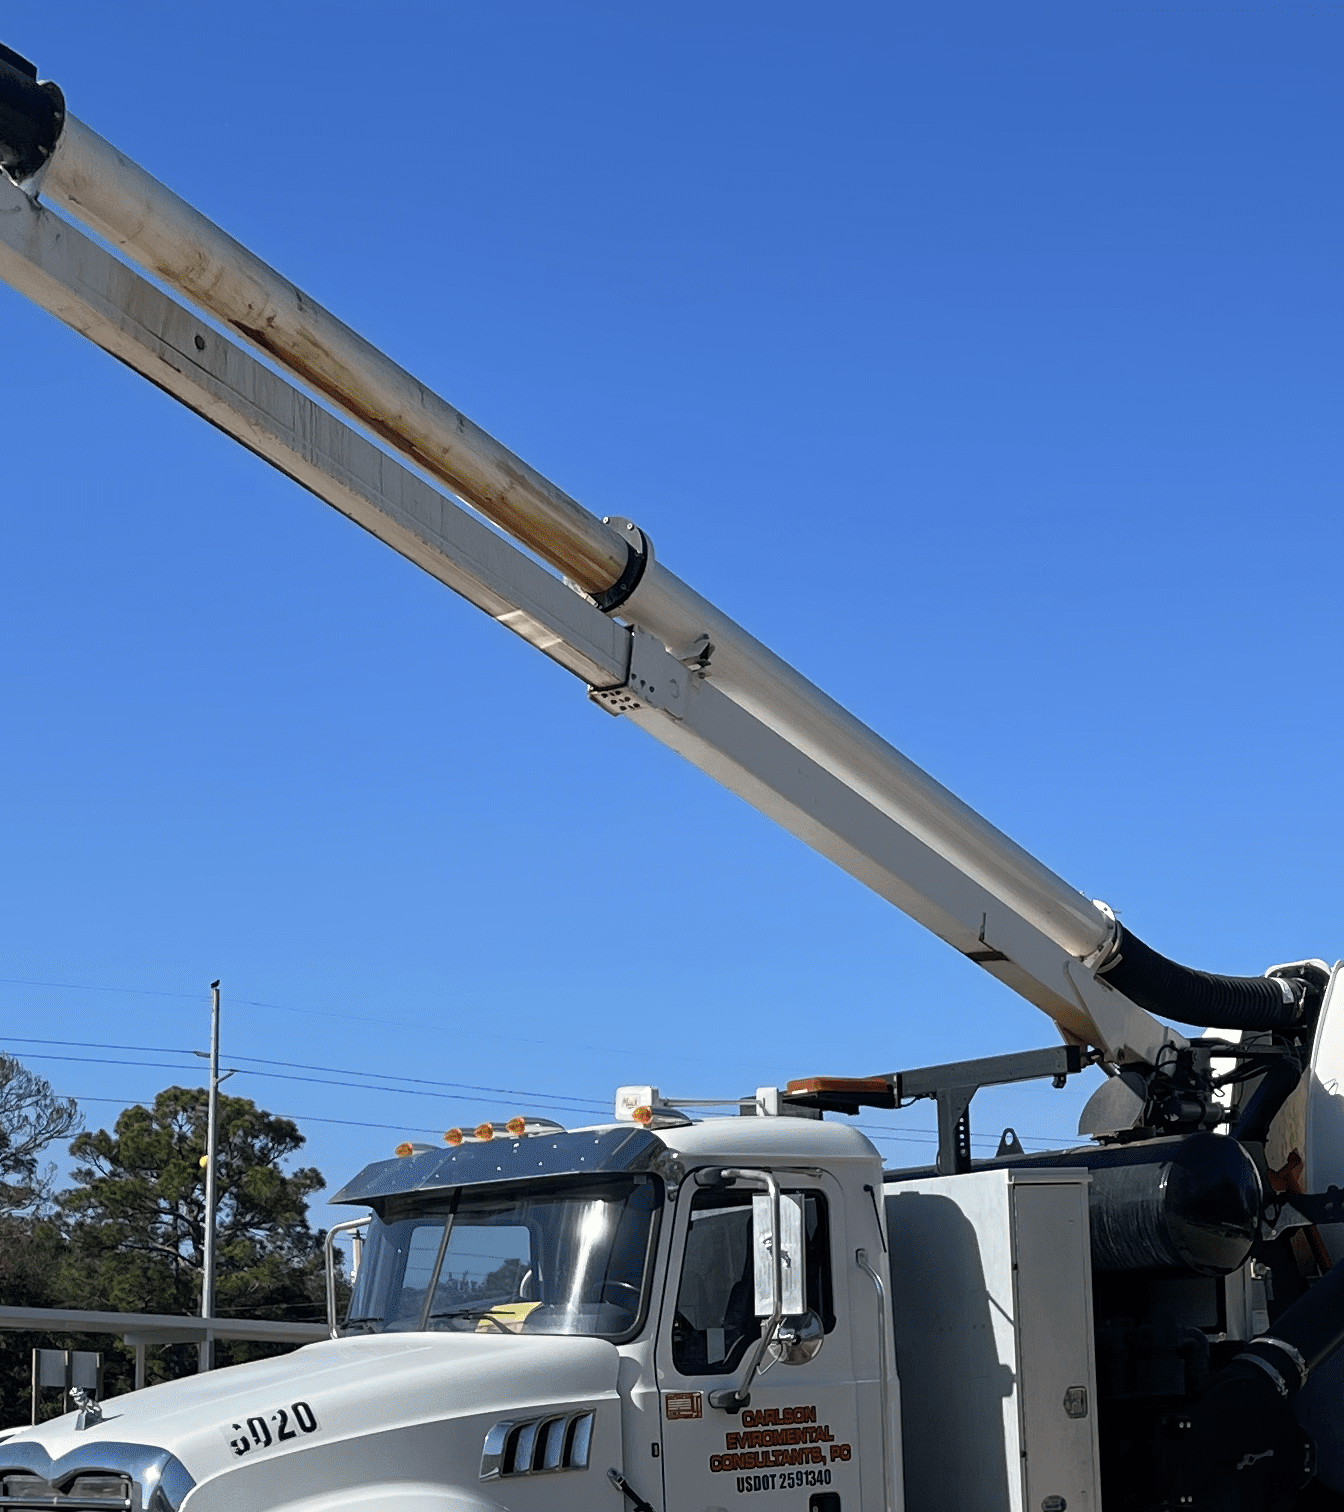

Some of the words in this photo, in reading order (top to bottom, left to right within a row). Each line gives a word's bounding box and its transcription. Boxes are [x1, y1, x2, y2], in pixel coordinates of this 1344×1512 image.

[742, 1406, 817, 1428] CARLSON
[710, 1446, 827, 1473] CONSULTANTS,
[830, 1443, 852, 1462] PC
[736, 1474, 777, 1493] USDOT
[779, 1469, 832, 1489] 2591340
